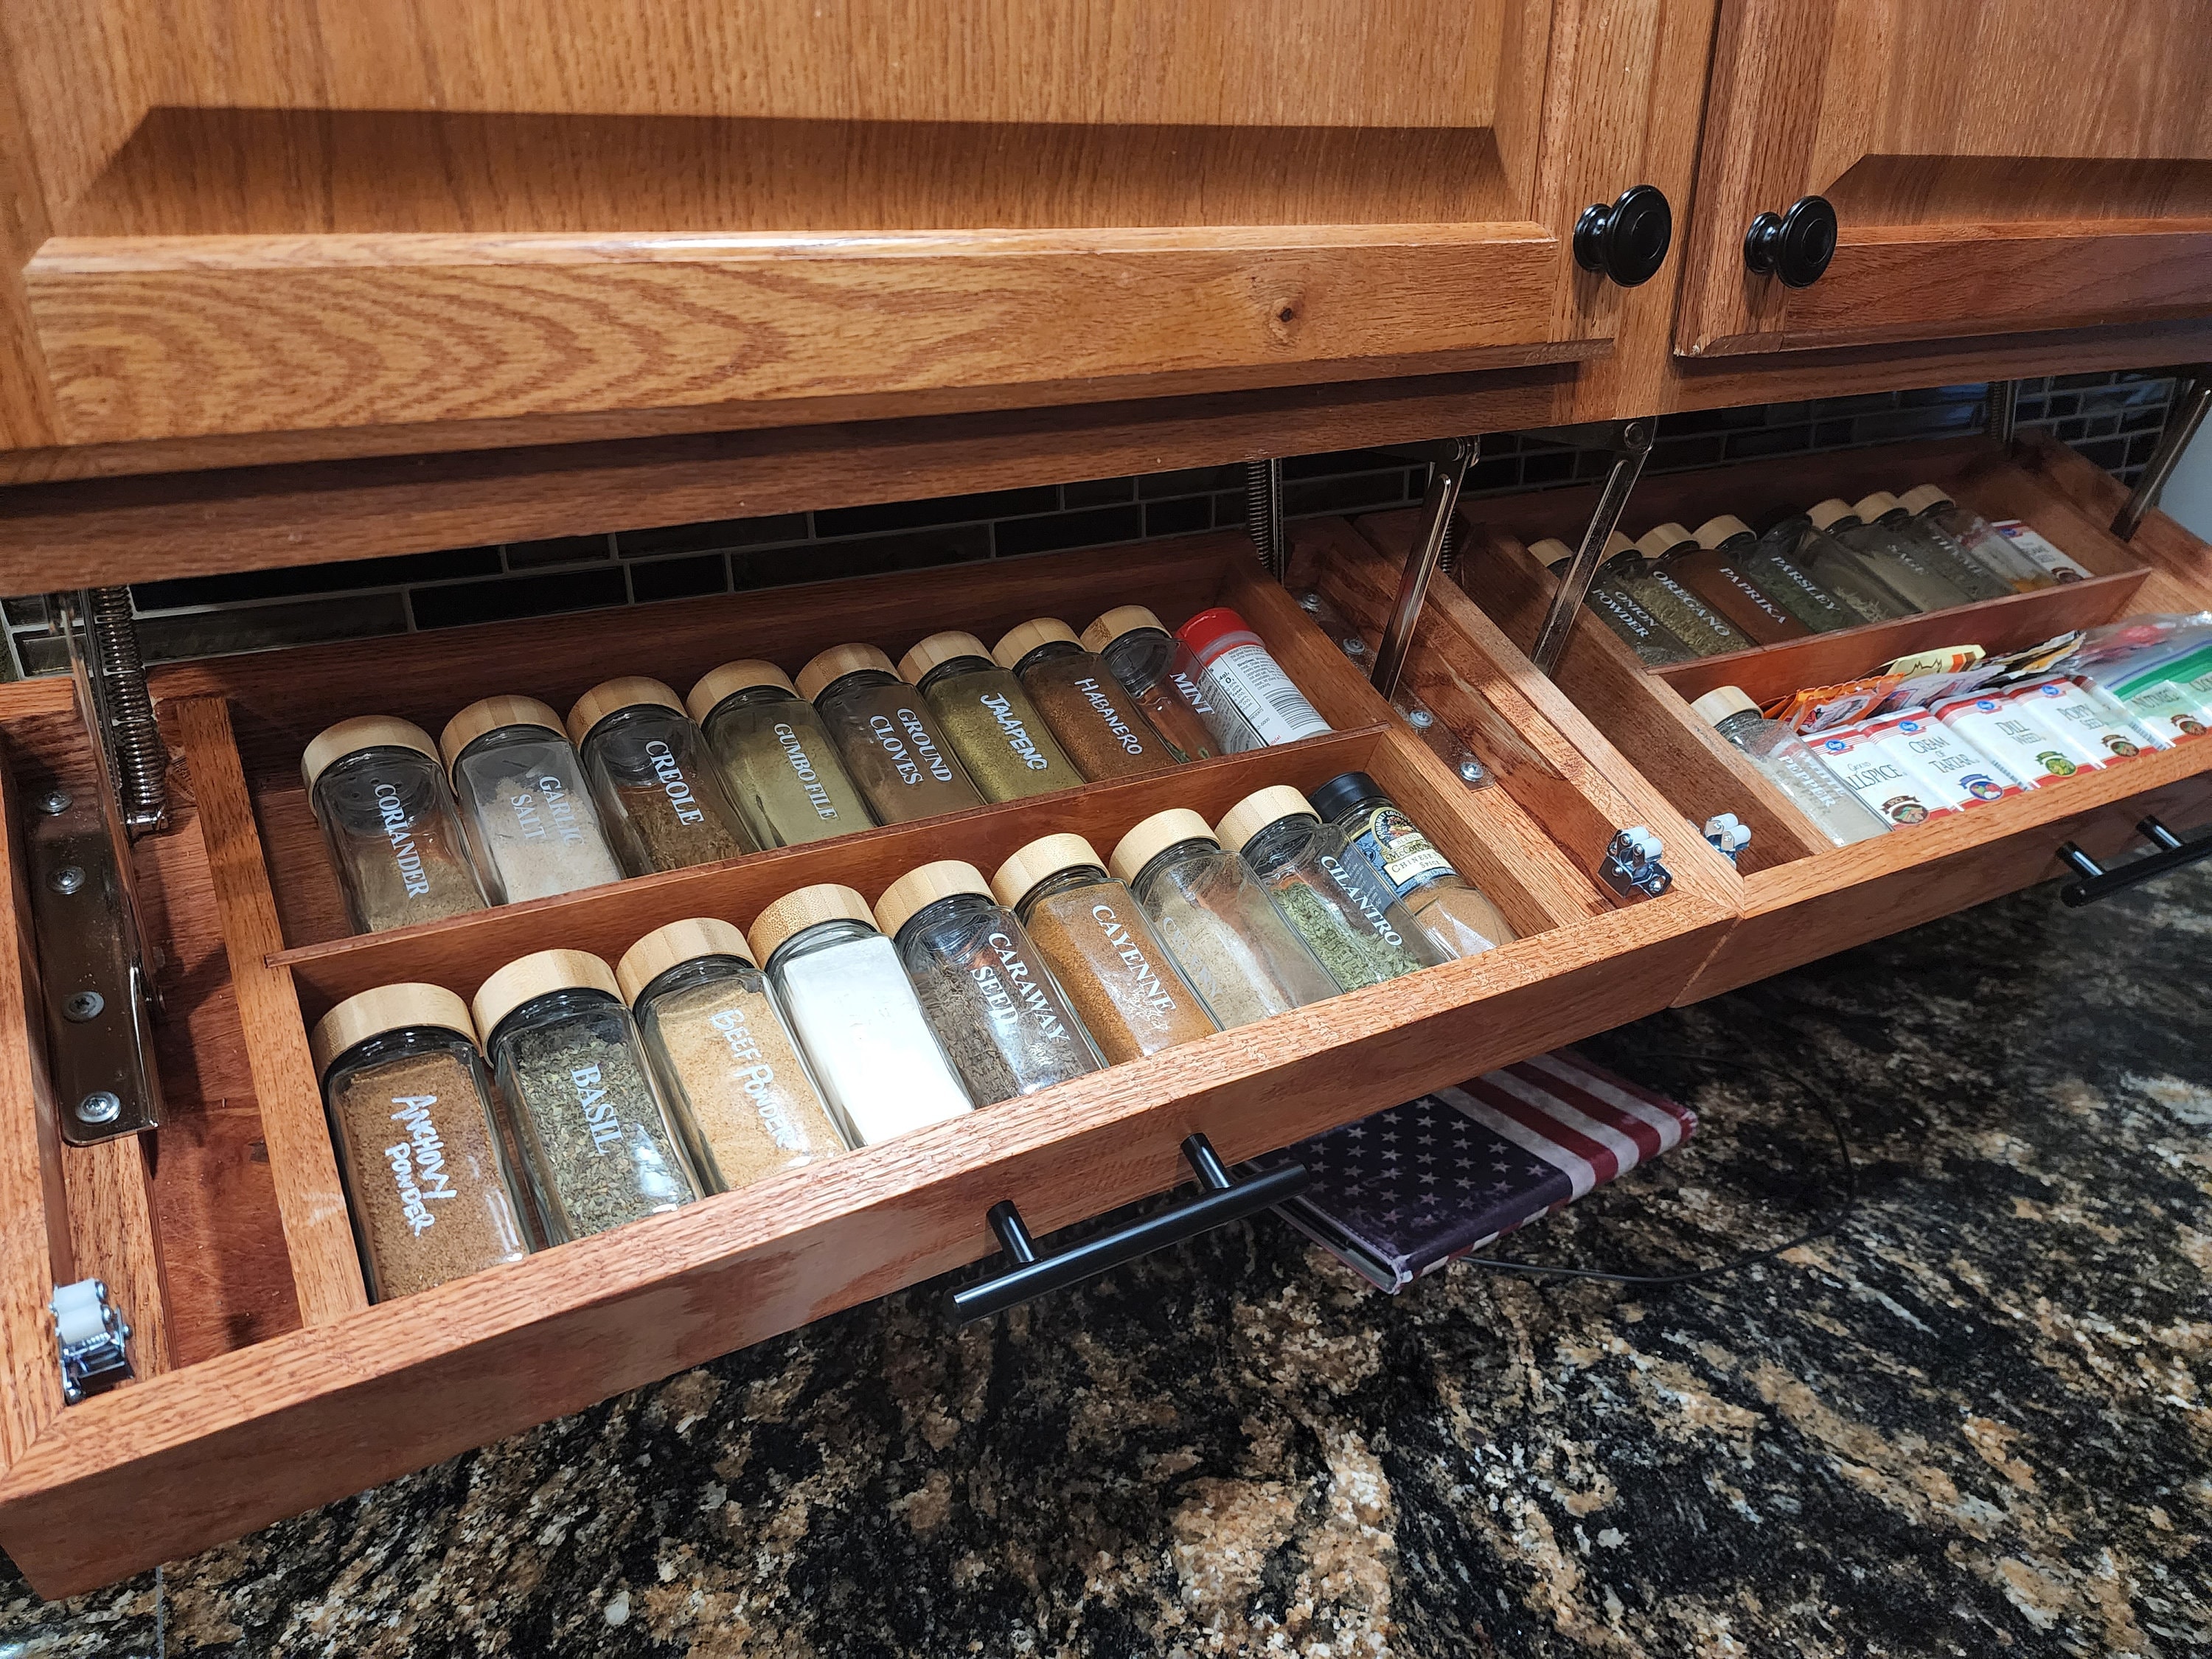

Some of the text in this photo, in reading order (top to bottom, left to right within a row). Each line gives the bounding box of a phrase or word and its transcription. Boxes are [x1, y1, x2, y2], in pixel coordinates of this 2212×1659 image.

[1591, 589, 1649, 638] POWDER
[1615, 591, 1660, 627] ONION
[1652, 571, 1731, 636] OREGANO
[1719, 567, 1787, 625] PAPRIKA
[1770, 556, 1841, 611] PARSLEY
[1074, 678, 1144, 756] HABANERO
[1169, 672, 1217, 715] MINT
[1995, 720, 2029, 736] DILL
[869, 715, 925, 785] CLOVES
[896, 708, 953, 782] GROUND
[980, 692, 1048, 771] JALAPENO
[1908, 736, 1950, 754] CREAM
[1928, 754, 1975, 773] TARTAR
[2011, 732, 2042, 745] WEED
[644, 740, 704, 826] CREOLE
[773, 723, 840, 822] GUMBO FILE
[1778, 755, 1836, 807] PEPPER
[373, 782, 431, 900] CORIANDER
[509, 793, 549, 839] SALT
[538, 776, 585, 846] GARLIC
[1374, 810, 1387, 840] GOURMET
[1321, 855, 1402, 947] CILANTRO
[988, 933, 1070, 1042] CARAWAY
[1092, 905, 1177, 1012] CAYENNE
[970, 965, 1020, 1027] SEED
[570, 1064, 625, 1155] BASIL
[709, 1008, 802, 1151] BEEF POWDER
[391, 1095, 457, 1199] ANCHOVY
[385, 1142, 436, 1238] POWDER
